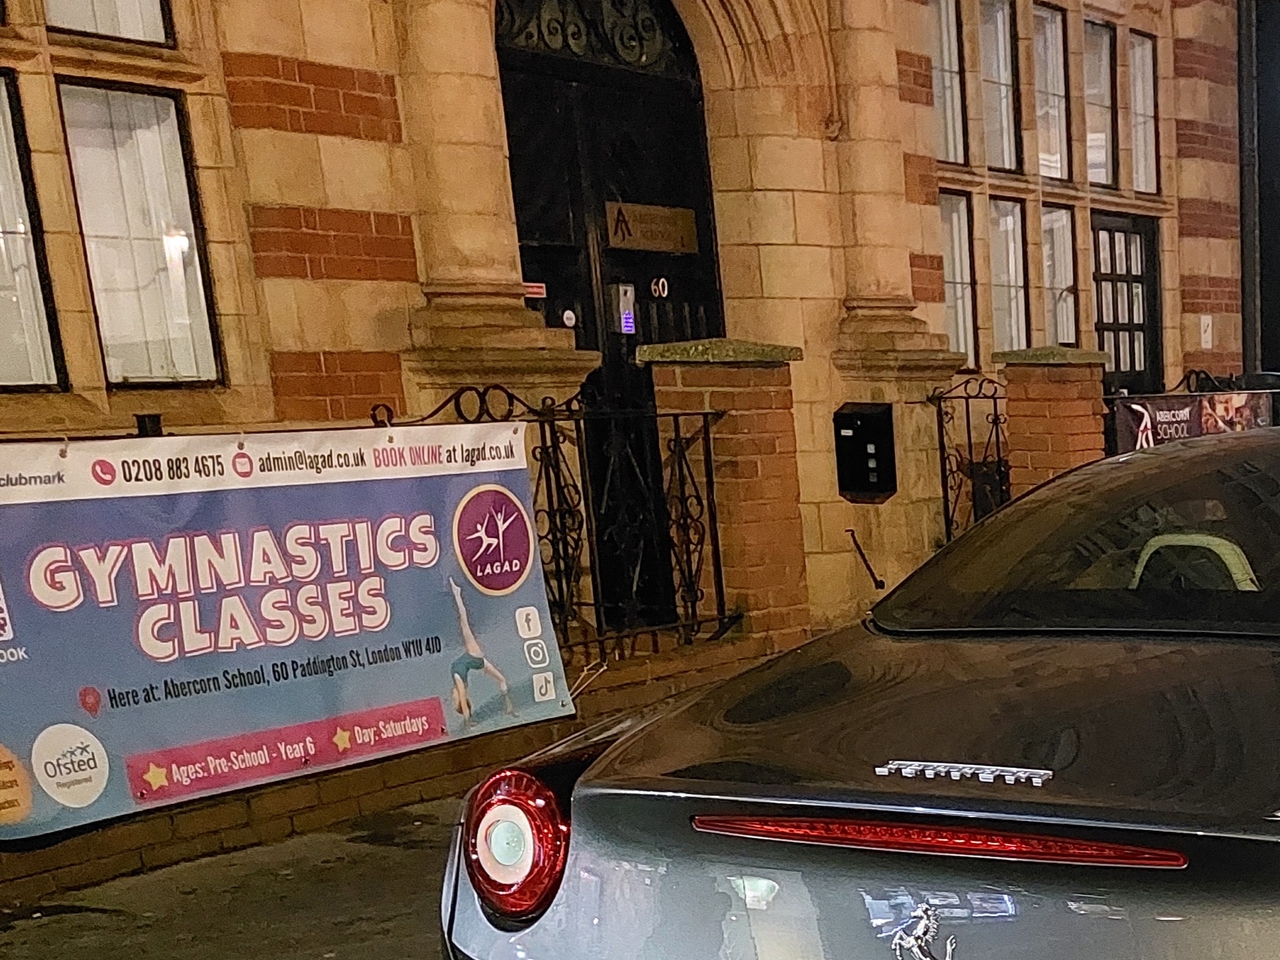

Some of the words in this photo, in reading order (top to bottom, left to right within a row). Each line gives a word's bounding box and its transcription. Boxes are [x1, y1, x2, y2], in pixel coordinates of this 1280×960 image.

[651, 278, 668, 297] 60
[1156, 409, 1190, 422] ABERCORN
[1157, 423, 1189, 439] SCHOOL
[121, 458, 163, 483] 0208
[167, 456, 190, 480] 883
[193, 454, 225, 478] 4675
[258, 447, 367, 474] admin@lagad.co.uk
[373, 446, 407, 468] BOOK
[409, 445, 443, 466] ONLINE
[445, 446, 459, 464] at
[460, 440, 516, 467] lagad.co.uk
[0, 471, 66, 487] clubmark
[28, 514, 440, 612] GYMNASTICS
[476, 559, 521, 577] LAGAD
[137, 576, 391, 663] CLASSES
[106, 688, 139, 709] Here
[143, 683, 161, 703] at:
[164, 678, 221, 700] Abercorn
[222, 664, 270, 690] School,
[272, 661, 290, 682] 60
[291, 655, 349, 679] Paddington
[350, 649, 365, 669] St,
[365, 644, 402, 666] London
[402, 637, 423, 659] W1U
[425, 636, 442, 654] 4JD
[354, 725, 379, 745] Day:
[379, 715, 429, 741] Saturdays
[44, 752, 98, 778] Ofsted
[171, 762, 208, 785] Ages:
[207, 745, 270, 775] Pre-School
[277, 741, 306, 761] Year
[306, 736, 315, 756] 6
